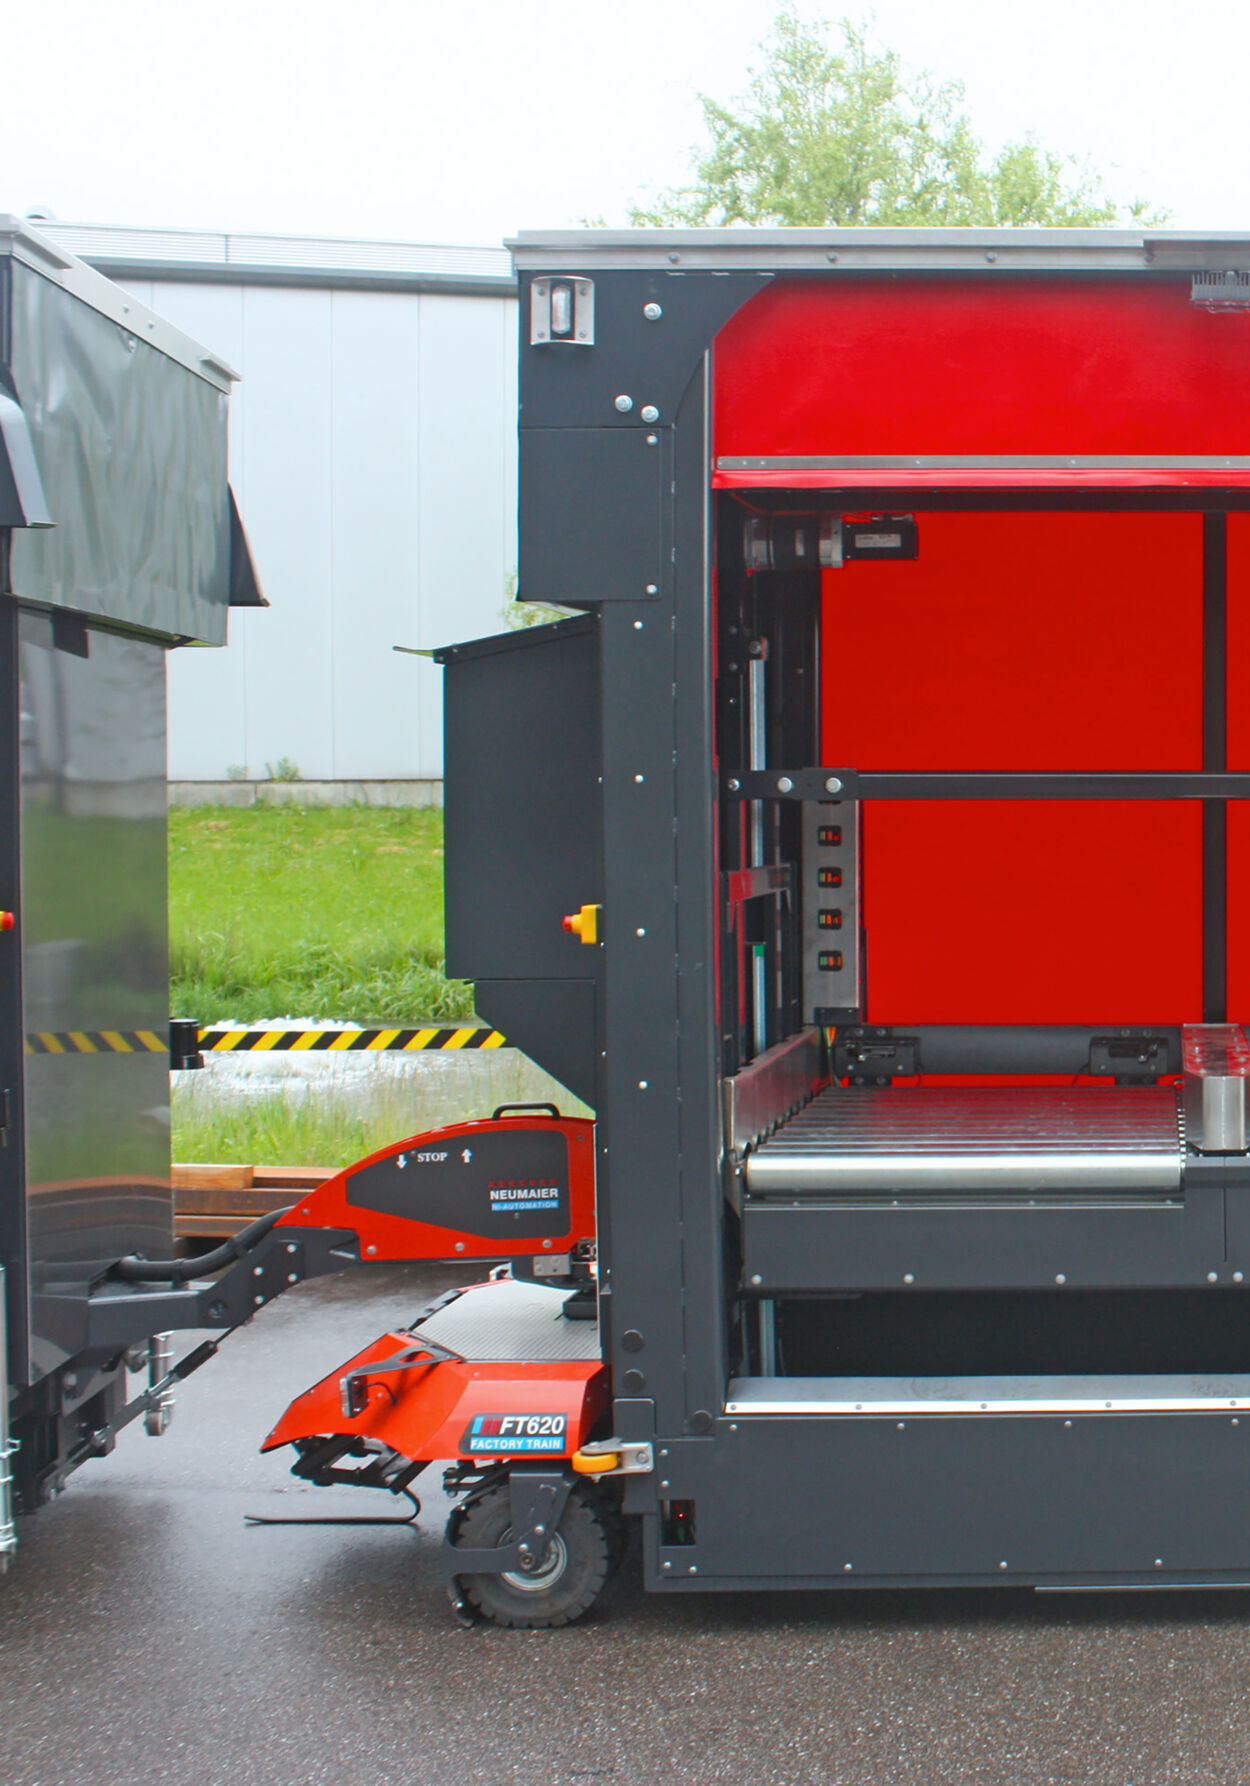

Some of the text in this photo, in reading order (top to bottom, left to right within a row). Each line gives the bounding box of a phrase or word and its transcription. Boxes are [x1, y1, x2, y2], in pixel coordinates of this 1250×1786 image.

[417, 1151, 448, 1163] STOP
[490, 1188, 559, 1200] NEUMAIER
[499, 1416, 564, 1434] FT620
[470, 1438, 560, 1450] FACTORY TRAIN
